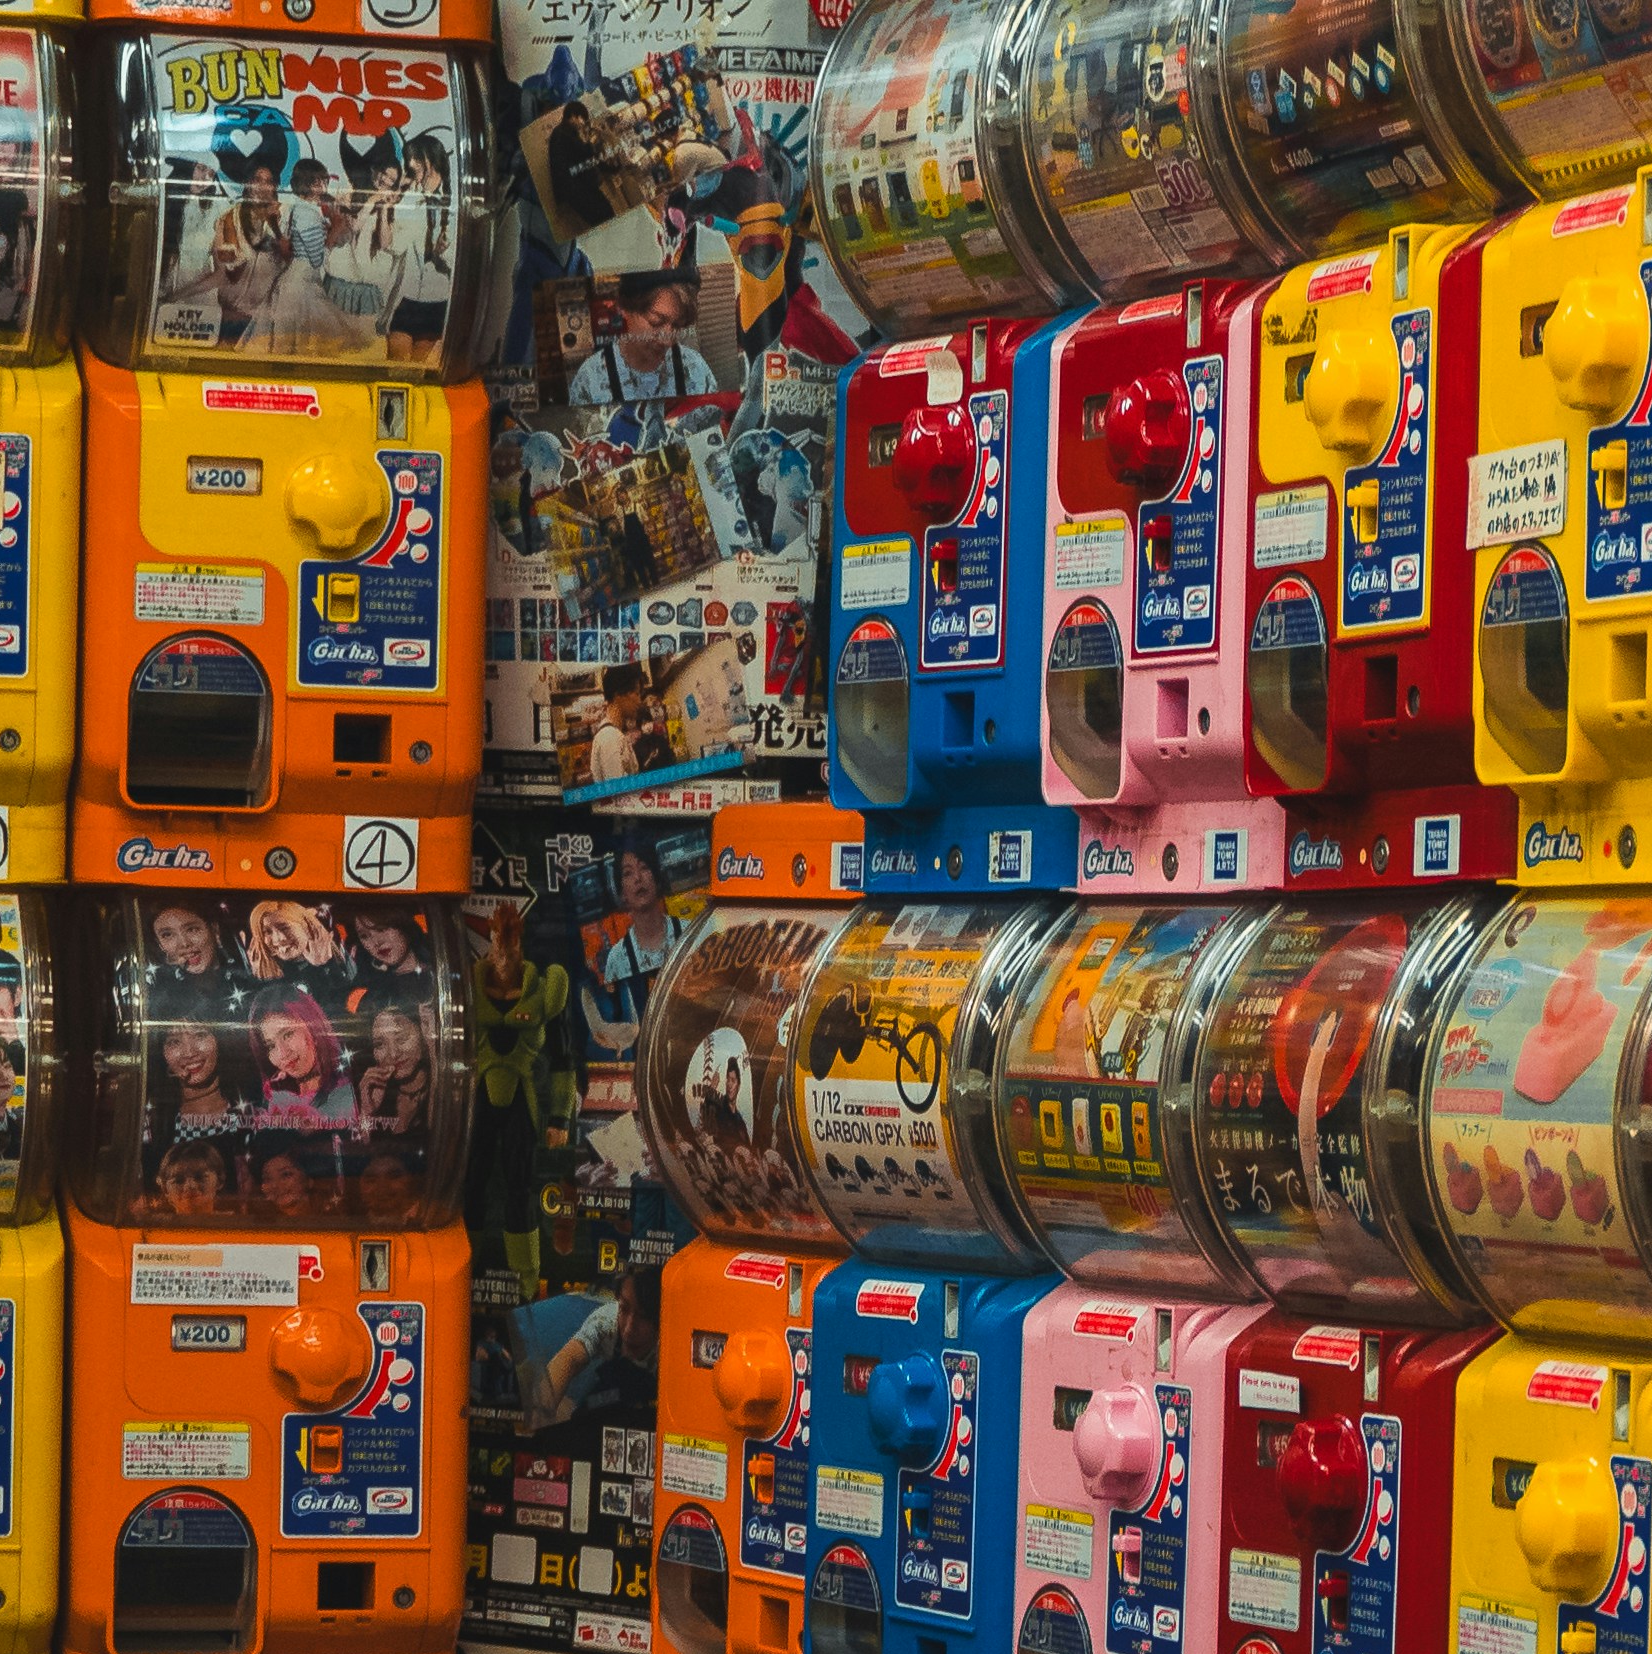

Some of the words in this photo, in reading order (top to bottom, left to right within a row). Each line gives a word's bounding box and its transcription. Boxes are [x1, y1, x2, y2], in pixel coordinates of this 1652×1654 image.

[177, 309, 204, 321] KEY
[163, 321, 215, 333] HOLDER
[196, 468, 247, 488] ¥200
[310, 640, 378, 664] Gacha.
[748, 702, 826, 749] 発売
[812, 1091, 842, 1119] 1/12
[815, 1120, 873, 1145] CARBON
[875, 1123, 905, 1147] GPX
[629, 1240, 675, 1254] MASTERLISE
[628, 1253, 673, 1265] 人造人間17
[473, 1280, 521, 1294] ASTERLISE
[180, 1324, 231, 1344] ¥200
[294, 1492, 359, 1515] Gacha.
